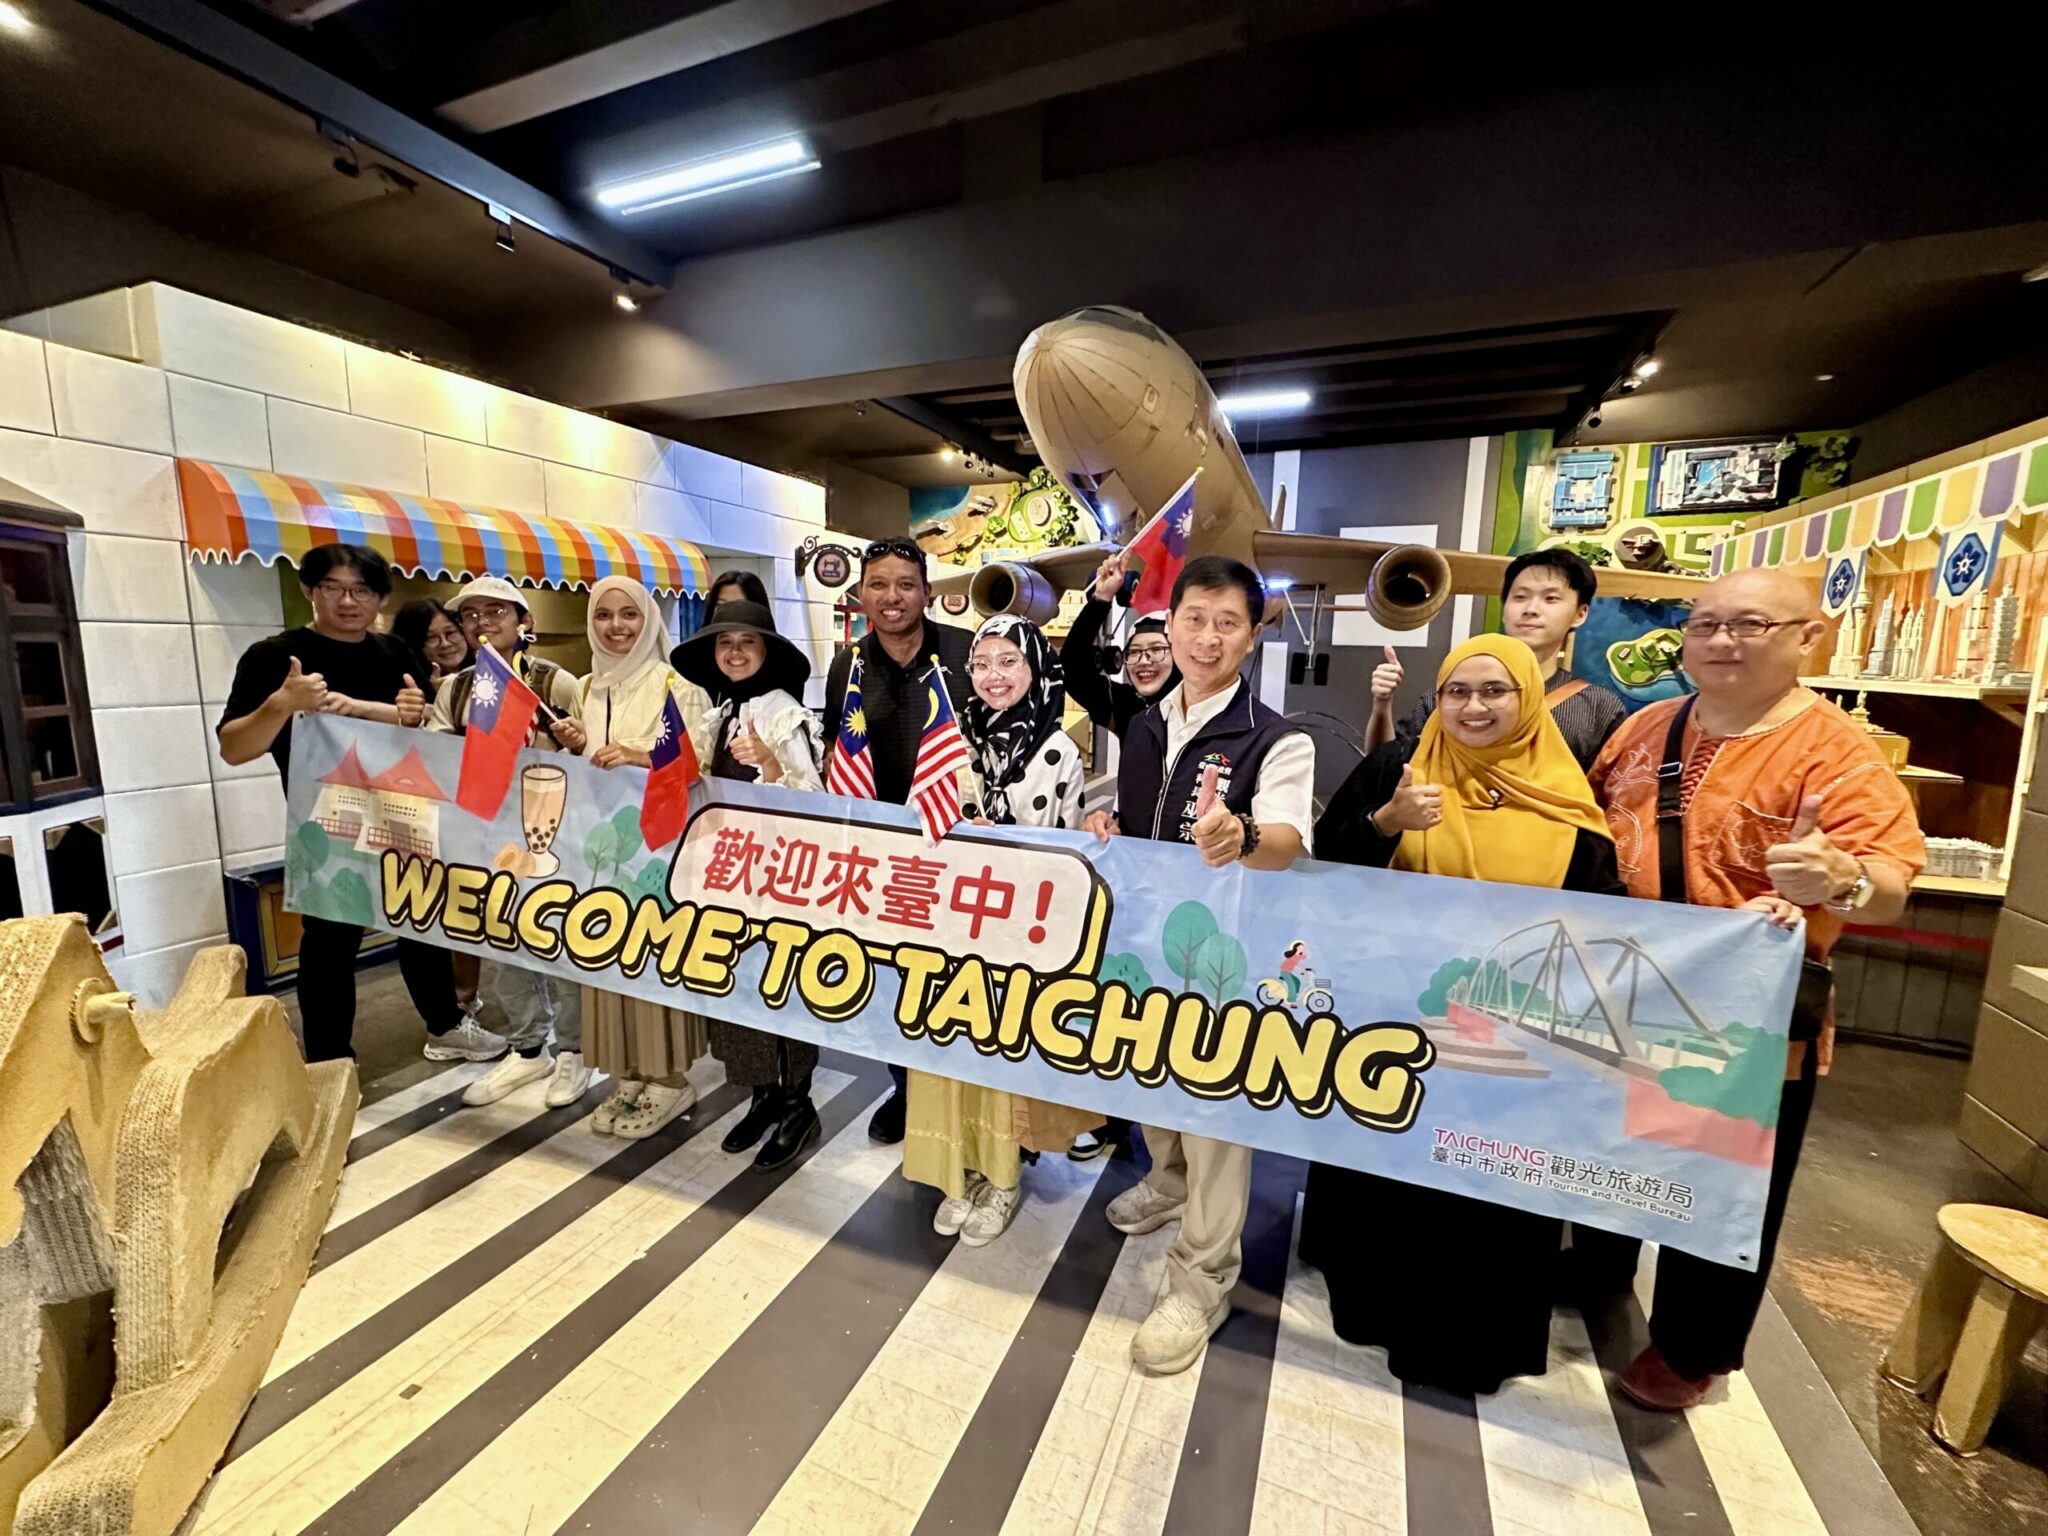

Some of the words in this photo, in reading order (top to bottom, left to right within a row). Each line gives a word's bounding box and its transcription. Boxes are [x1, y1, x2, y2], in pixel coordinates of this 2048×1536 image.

[702, 827, 1054, 944] 歡迎來臺中!
[380, 849, 750, 995] WELCOME
[759, 919, 876, 1022] TO
[894, 942, 1437, 1134] TAICHUNG
[1432, 1146, 1543, 1186] 臺中市政府
[1434, 1128, 1546, 1167] TAICHUNG
[1549, 1179, 1589, 1195] Tourism
[1591, 1190, 1612, 1201] and
[1614, 1193, 1647, 1209] Travel
[1649, 1202, 1691, 1222] Bureau
[1551, 1154, 1693, 1209] 觀光旅遊局
